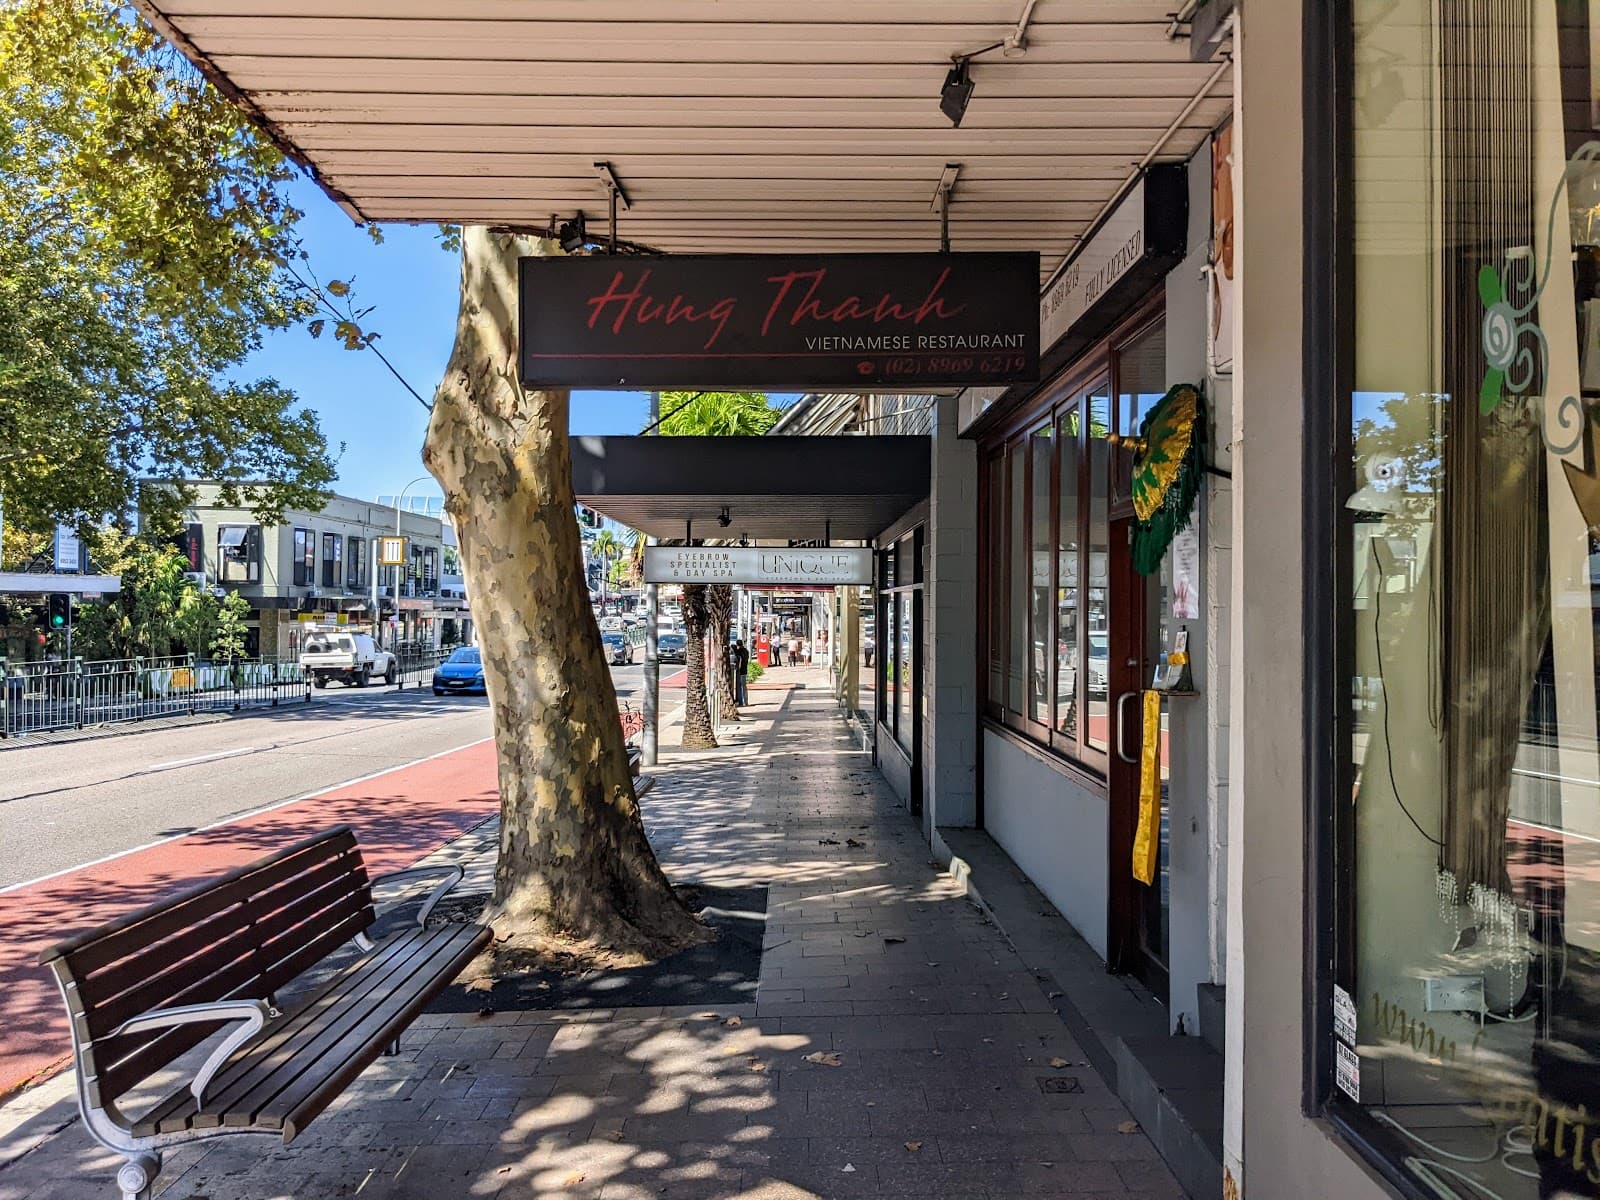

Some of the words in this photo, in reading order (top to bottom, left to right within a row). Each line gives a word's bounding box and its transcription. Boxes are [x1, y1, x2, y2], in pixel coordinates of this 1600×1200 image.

[1085, 267, 1104, 306] FULLY
[1107, 230, 1141, 285] LICENSED
[586, 269, 738, 350] Hung
[761, 266, 968, 337] Thanh
[805, 335, 911, 350] VIETNAMESE
[918, 334, 1025, 349] RESTAURANT
[885, 358, 921, 375] (02)
[927, 356, 974, 374] 8969
[979, 355, 1026, 373] 6219
[670, 561, 738, 569] SPECIALIST
[678, 553, 730, 561] EYEBROW
[761, 554, 850, 575] UNIQUE
[673, 569, 680, 577] &
[686, 569, 707, 577] DAY
[713, 569, 734, 577] SPA
